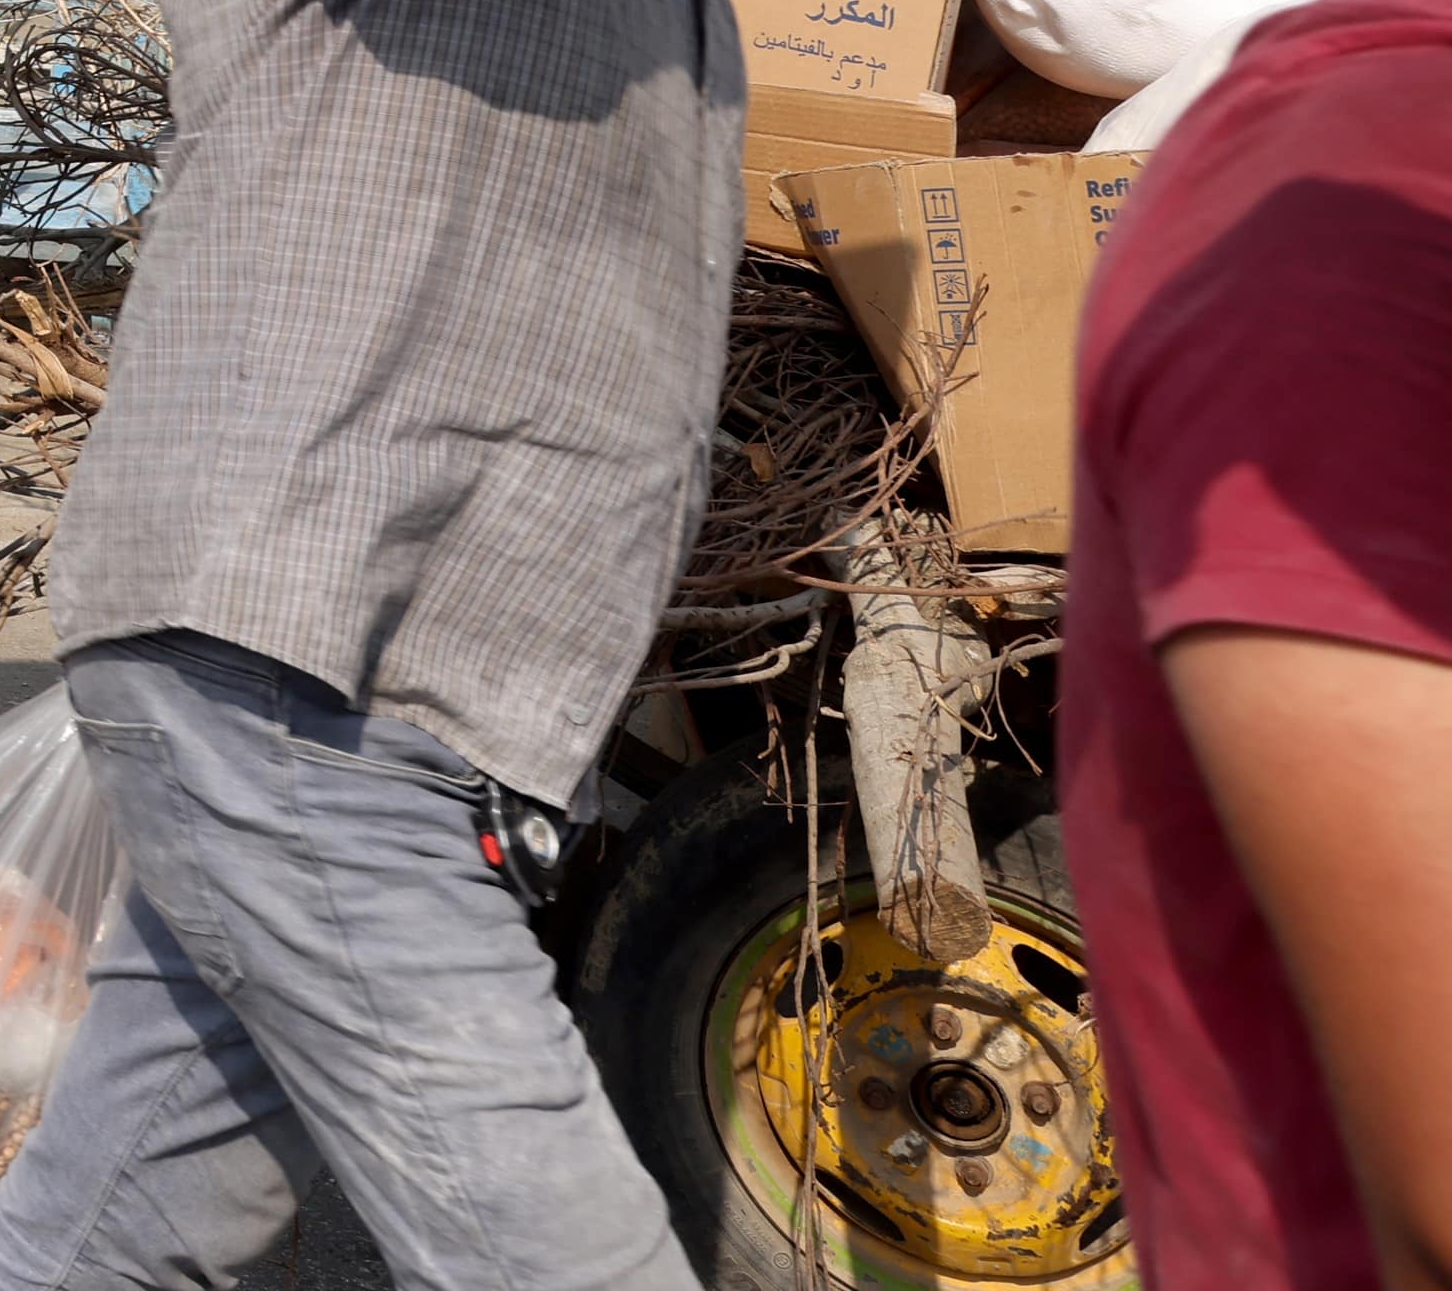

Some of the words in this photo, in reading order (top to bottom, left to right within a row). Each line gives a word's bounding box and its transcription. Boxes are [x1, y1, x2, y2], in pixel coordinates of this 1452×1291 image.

[753, 31, 834, 63] بالفيتامين
[839, 53, 887, 71] مدعم
[831, 69, 842, 81] د
[847, 77, 861, 90] و
[1086, 178, 1131, 198] Refi
